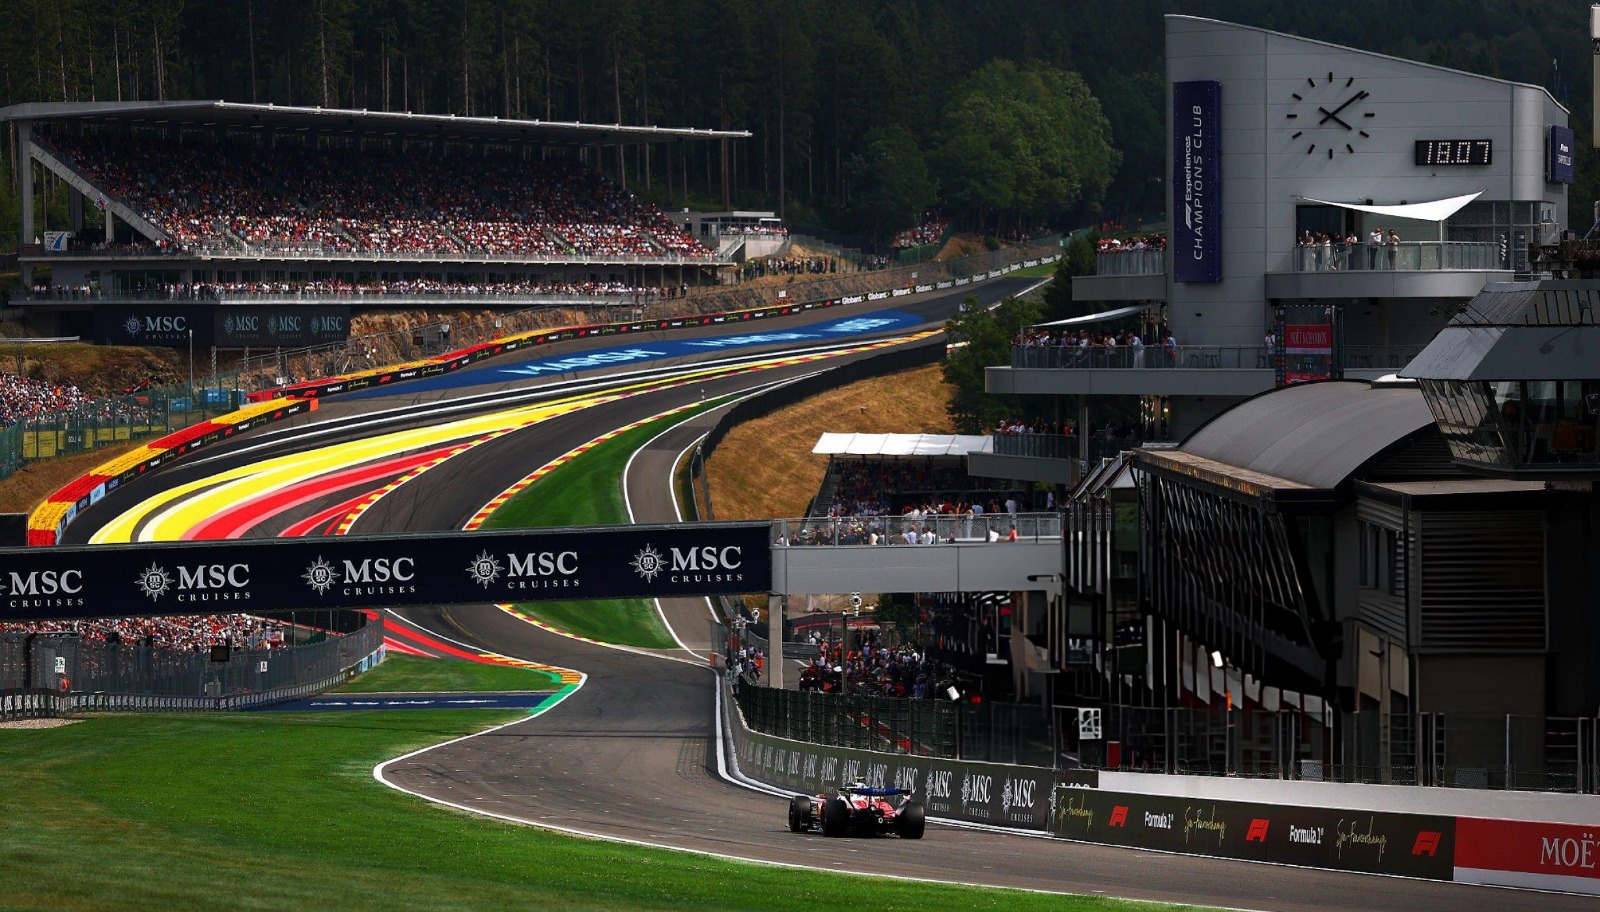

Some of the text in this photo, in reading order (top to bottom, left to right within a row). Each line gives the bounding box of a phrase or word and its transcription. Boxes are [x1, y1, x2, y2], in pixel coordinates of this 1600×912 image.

[1427, 142, 1490, 163] 18.07
[1193, 105, 1202, 260] CHAMPIONS CLUB
[145, 316, 186, 331] MSC
[236, 316, 259, 331] MSC
[279, 316, 302, 331] MSC
[321, 316, 343, 331] MSC
[507, 551, 579, 577] MSC
[670, 546, 742, 571] MSC
[176, 564, 250, 590] MSC
[342, 557, 415, 584] MSC
[671, 574, 743, 583] CRUISES
[9, 570, 82, 595] MSC
[343, 586, 416, 596] CRUISES
[507, 580, 580, 589] CRUISES
[10, 598, 84, 608] CRUISES
[178, 592, 251, 601] CRUISES
[902, 766, 918, 794] MSC
[933, 770, 952, 798] MSC
[970, 774, 992, 803] MSC
[1012, 778, 1036, 808] MSC
[968, 807, 989, 818] CRUISES
[1010, 813, 1033, 823] CRUISES
[1144, 811, 1167, 828] Formula
[1289, 825, 1316, 844] Formula
[1540, 832, 1600, 869] MOË
